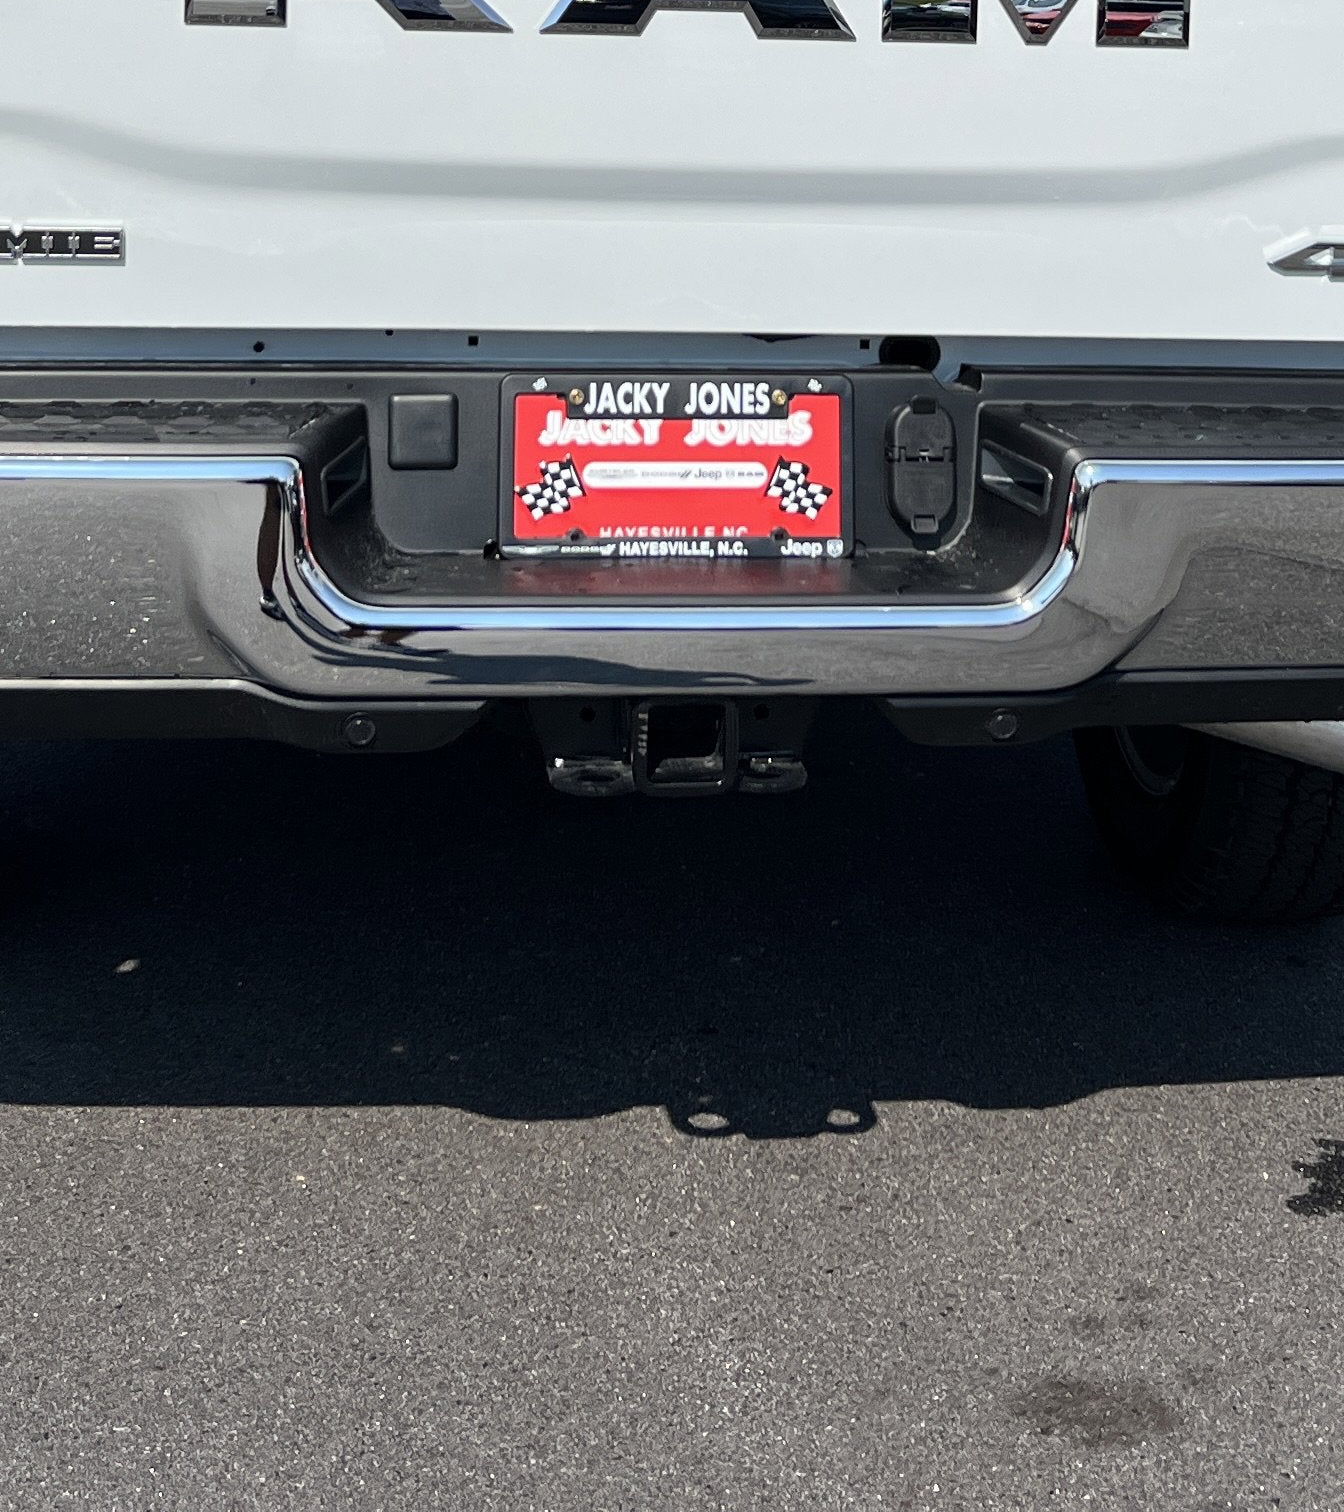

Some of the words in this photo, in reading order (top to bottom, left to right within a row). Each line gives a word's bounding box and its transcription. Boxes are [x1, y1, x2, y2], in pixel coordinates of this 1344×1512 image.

[583, 381, 670, 415] JACKY
[684, 381, 770, 415] JONES
[537, 410, 664, 446] JACKY
[683, 410, 813, 446] JONES
[694, 467, 723, 481] Jeep
[619, 540, 715, 558] HAYESVILLE,
[717, 540, 749, 556] N.C.
[780, 538, 823, 558] Jeep
